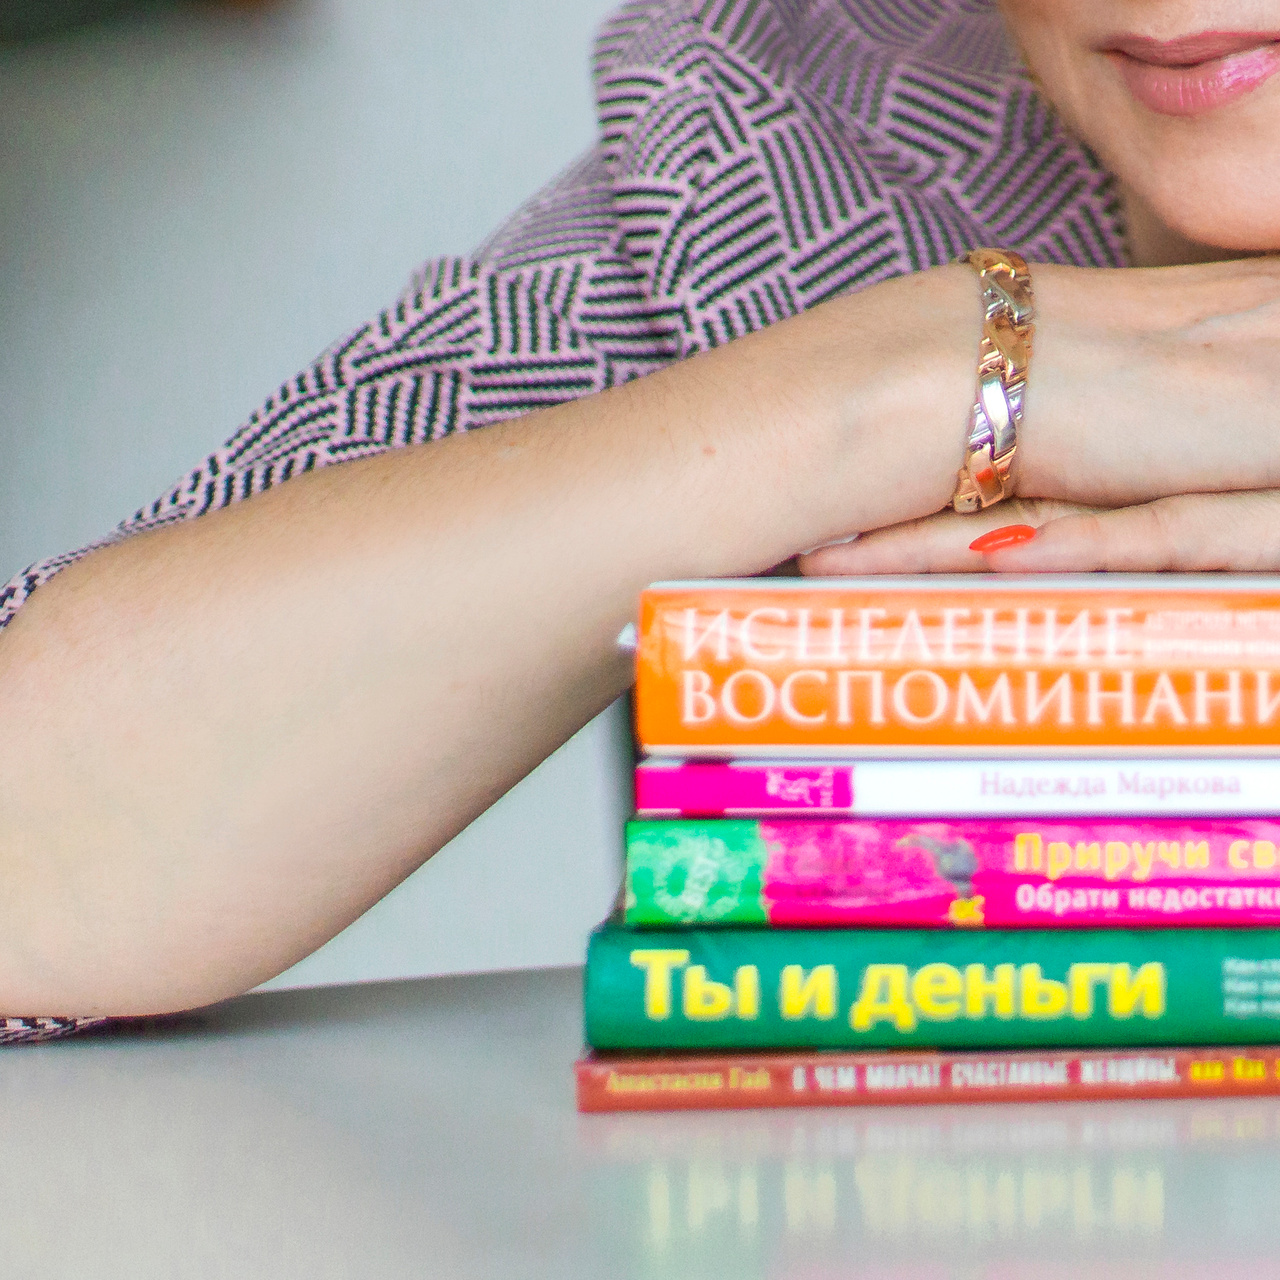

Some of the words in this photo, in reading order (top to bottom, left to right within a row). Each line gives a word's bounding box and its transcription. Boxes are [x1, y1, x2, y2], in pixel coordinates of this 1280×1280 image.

[680, 606, 1134, 663] ИСЦЕЛЕНИЕ
[979, 769, 1107, 800] Надежда
[1116, 769, 1242, 801] Маркова
[1014, 832, 1210, 881] Приручи
[1016, 882, 1120, 913] Обрати
[630, 949, 760, 1019] Ты
[780, 964, 837, 1018] и
[850, 961, 1166, 1031] деньги
